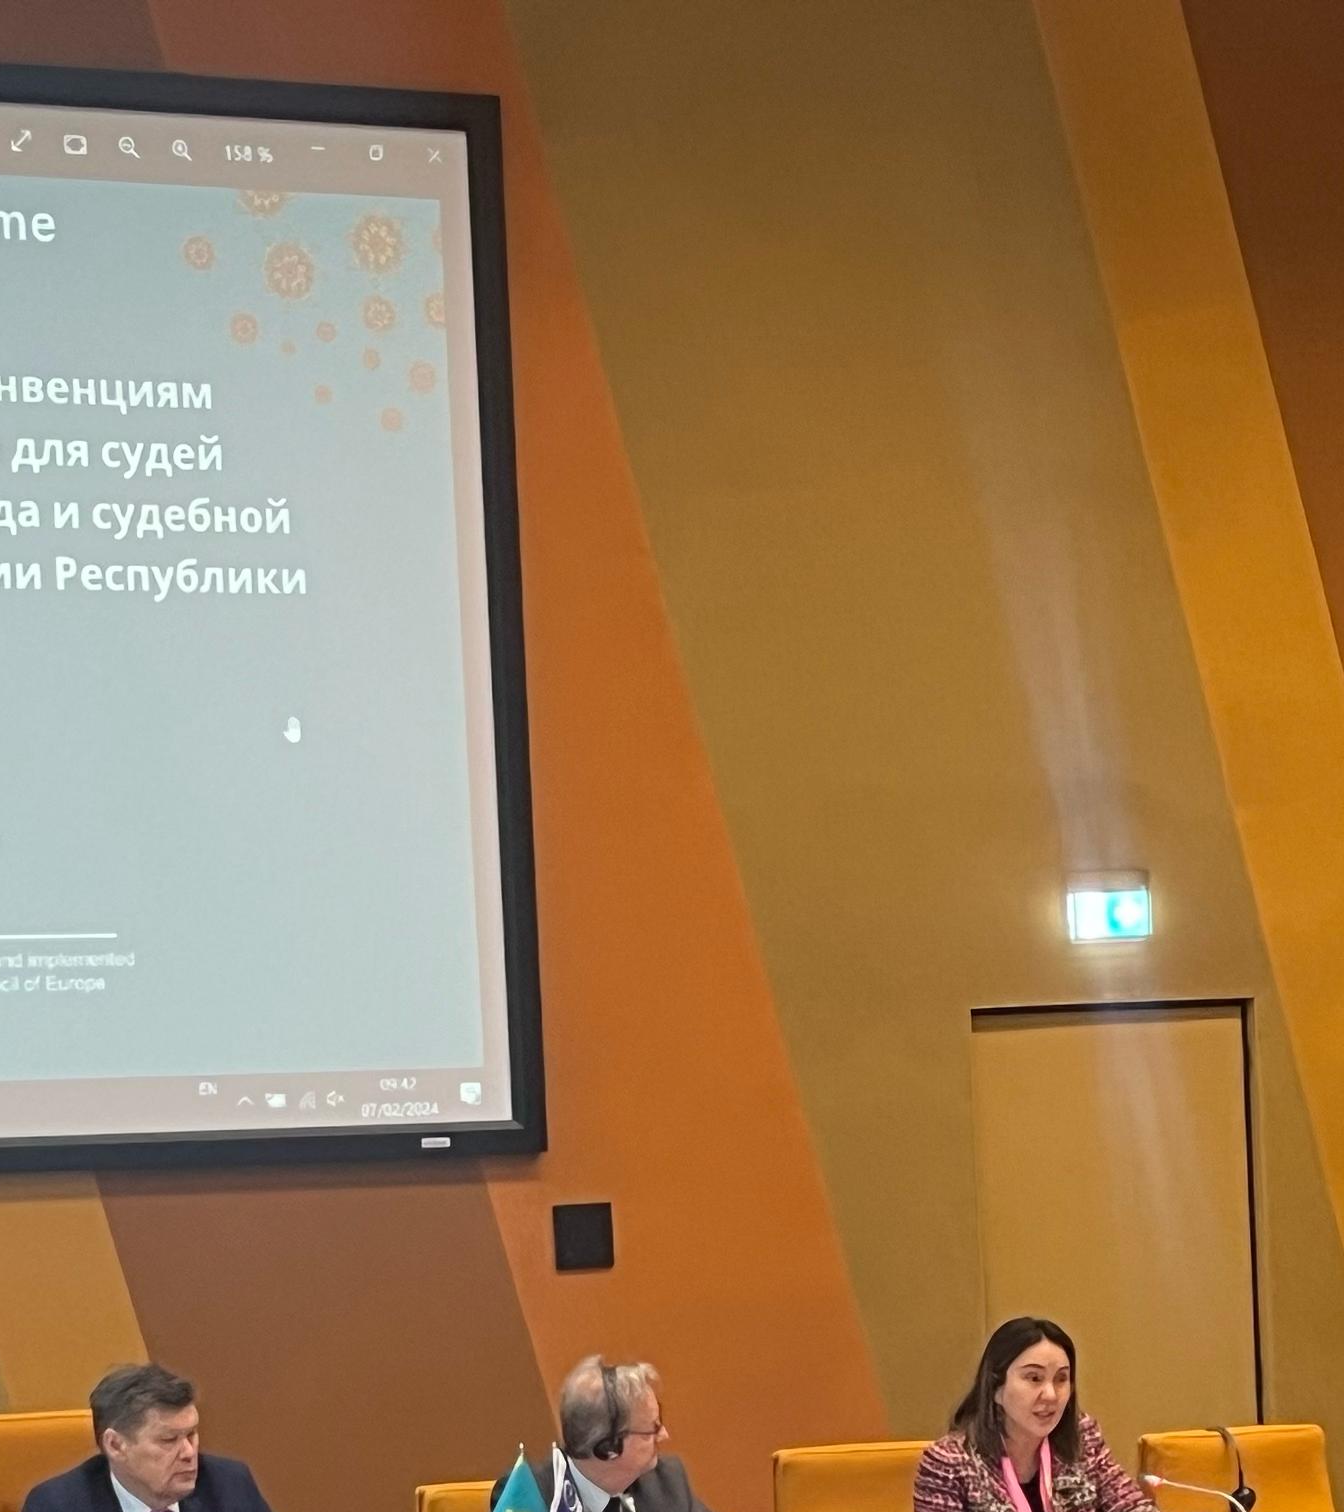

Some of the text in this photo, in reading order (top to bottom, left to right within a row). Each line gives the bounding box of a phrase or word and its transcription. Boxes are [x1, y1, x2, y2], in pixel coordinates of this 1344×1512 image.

[10, 437, 89, 474] для
[101, 434, 223, 480] судей
[53, 501, 80, 529] и
[92, 497, 291, 541] судебной
[55, 555, 307, 603] Республики
[23, 976, 41, 992] of
[45, 975, 106, 993] Europe
[197, 1081, 218, 1096] EN
[360, 1102, 440, 1119] 07/02/2024
